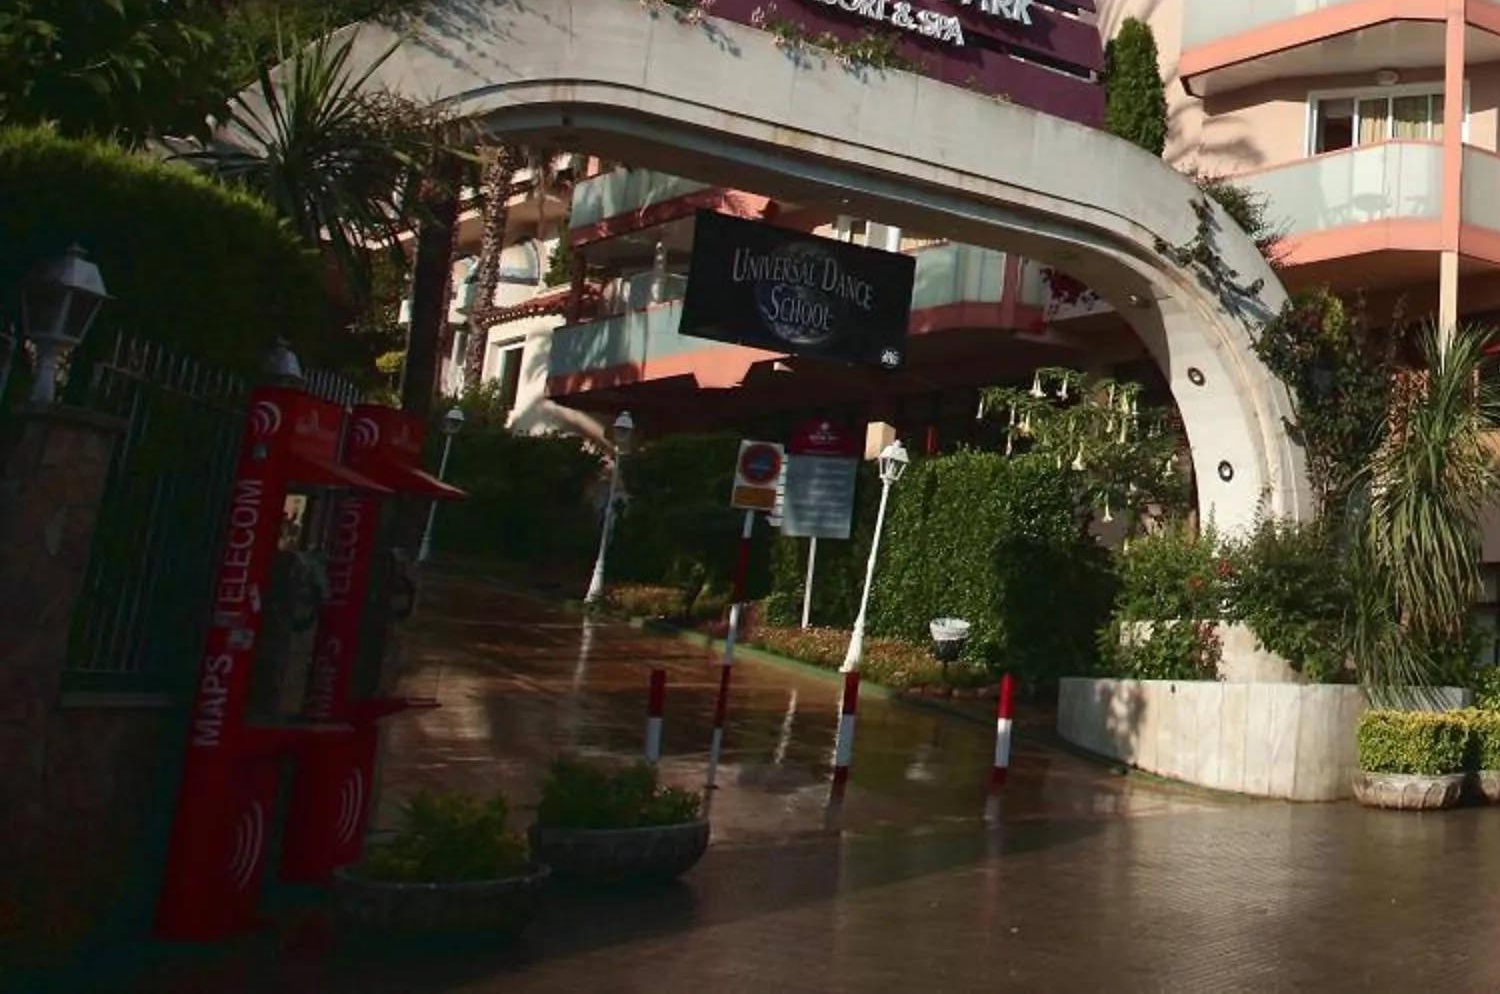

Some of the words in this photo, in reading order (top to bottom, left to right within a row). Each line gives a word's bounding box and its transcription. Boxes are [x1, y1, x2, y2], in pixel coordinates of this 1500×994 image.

[891, 1, 917, 30] &
[916, 8, 966, 47] SPA
[731, 247, 817, 287] UNIVERSAL
[821, 257, 875, 311] DANCE
[767, 285, 836, 331] SCHOOL
[192, 652, 236, 748] MAPS
[214, 478, 264, 629] TELECOM
